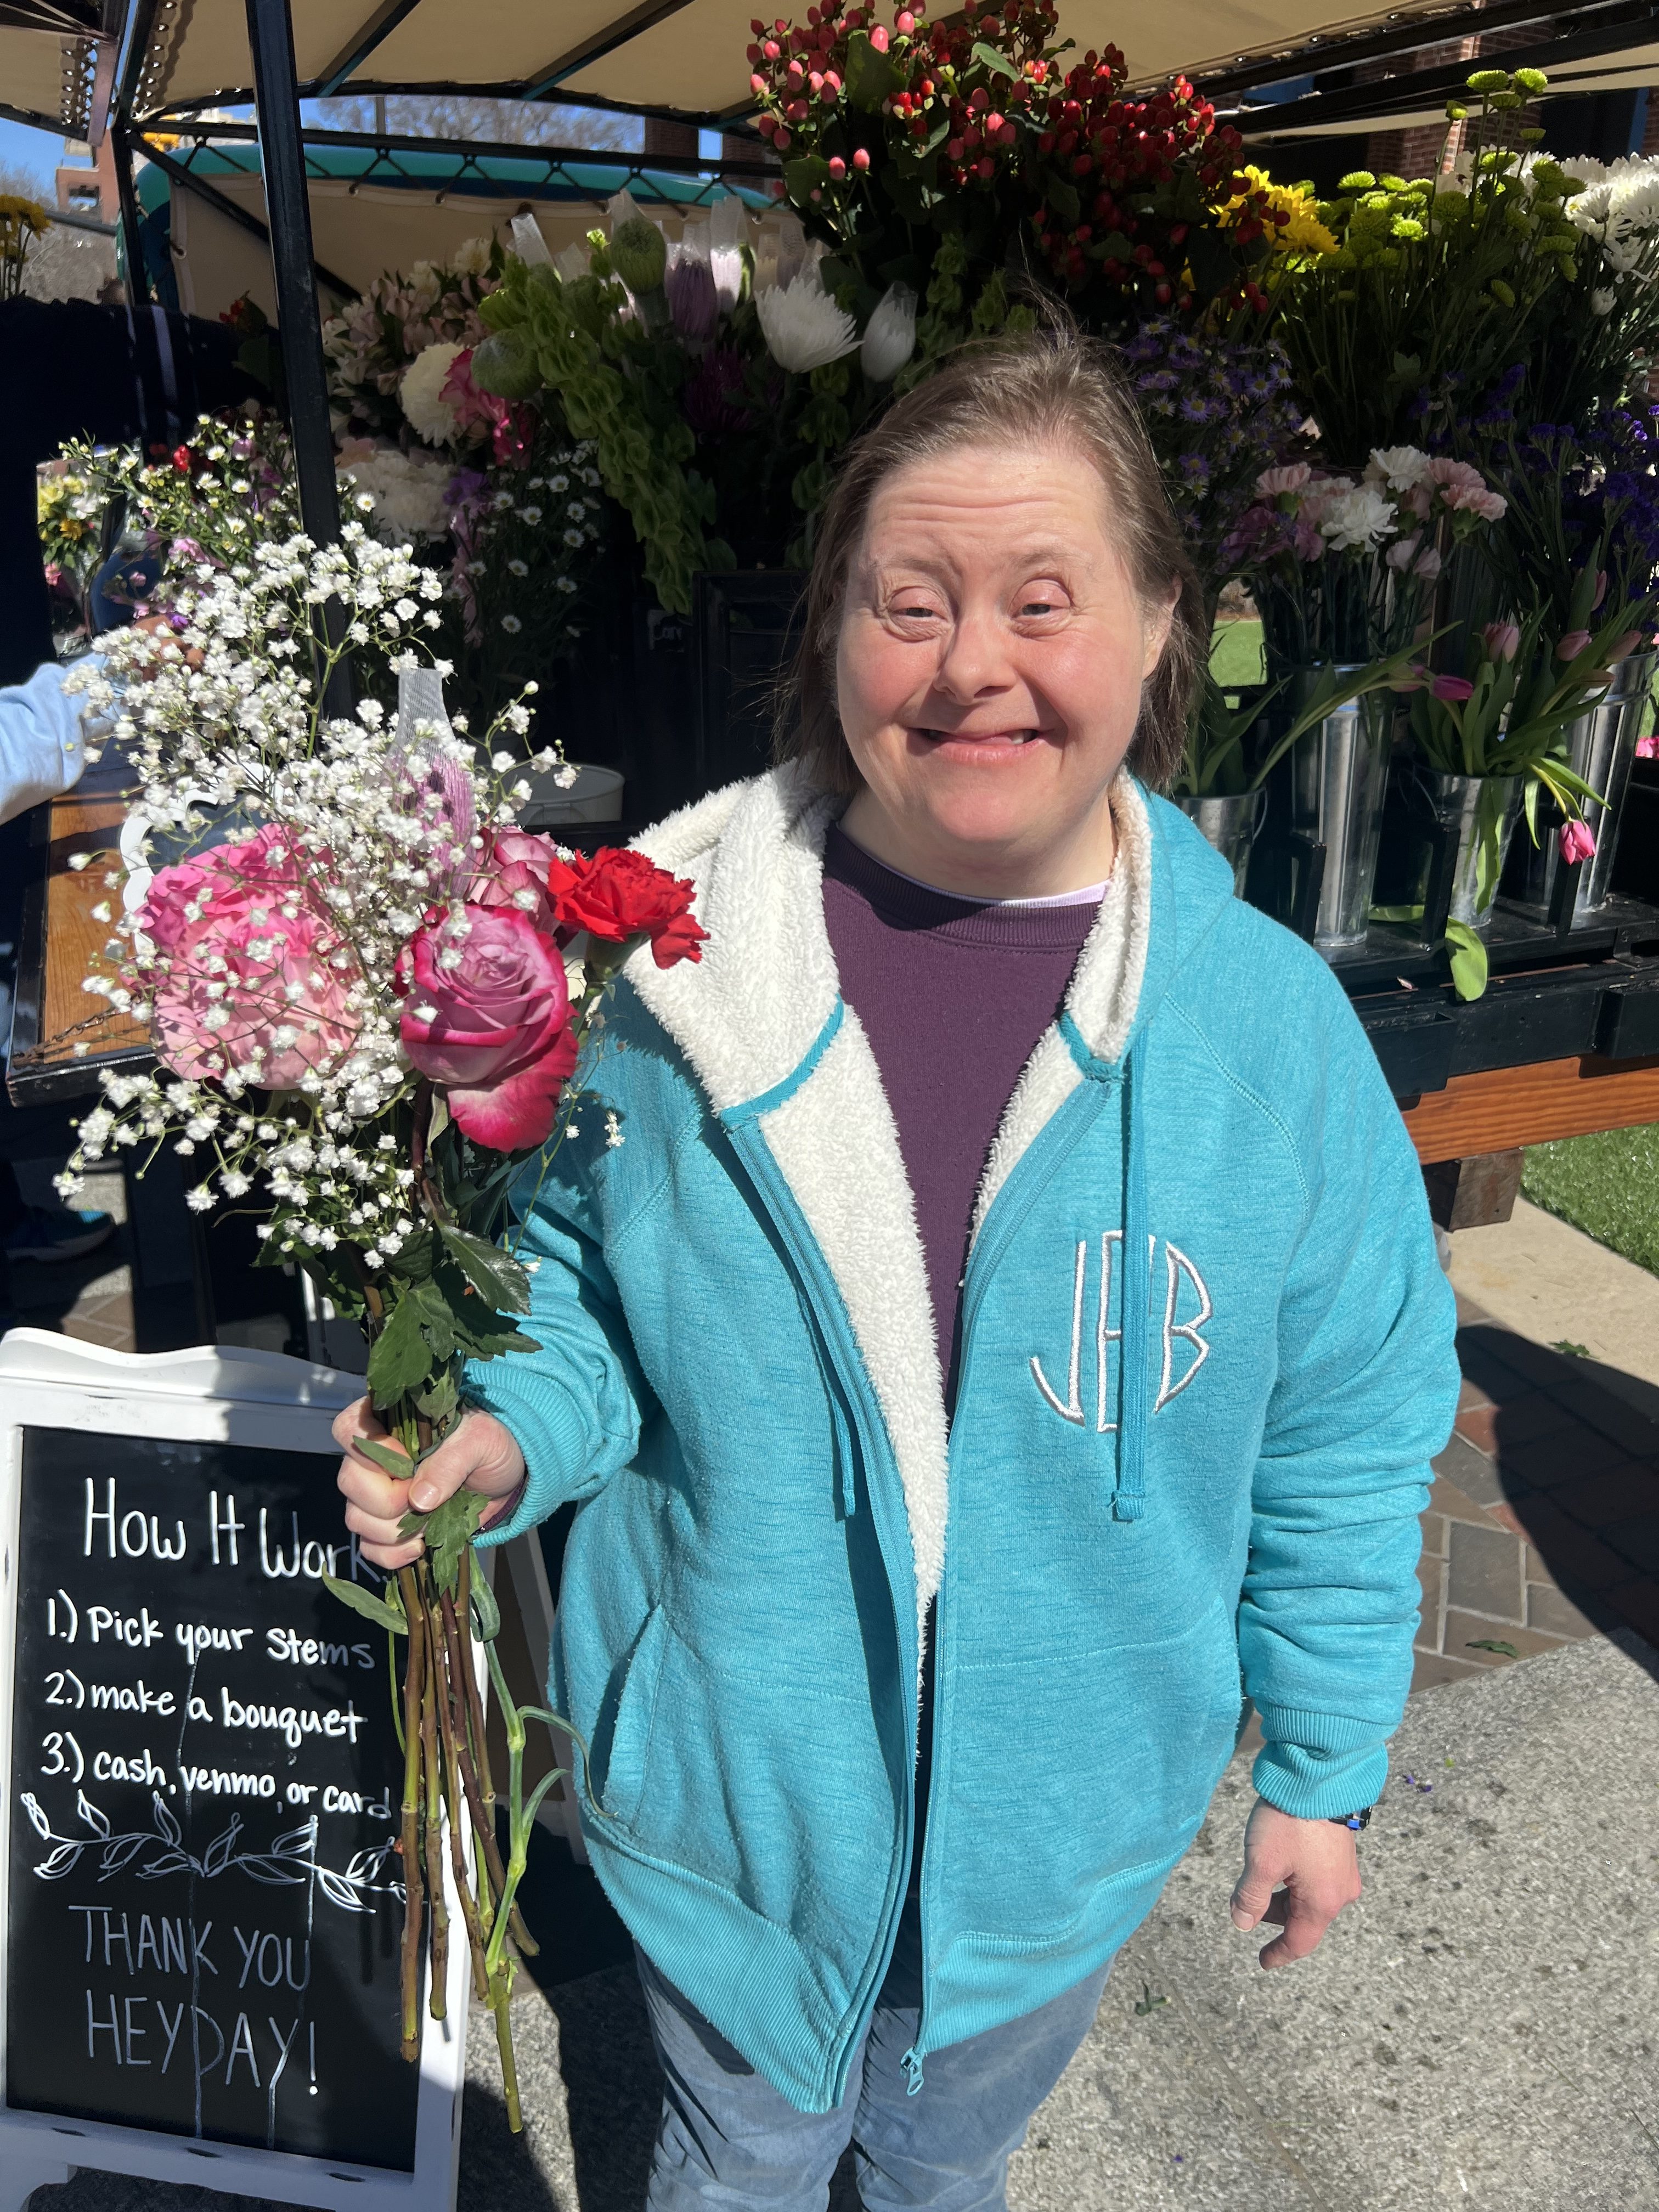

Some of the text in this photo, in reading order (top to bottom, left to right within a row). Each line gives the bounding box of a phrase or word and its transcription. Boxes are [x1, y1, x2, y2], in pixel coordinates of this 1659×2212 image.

[83, 1477, 388, 1583] How It Work
[47, 1589, 78, 1643] 1.)
[87, 1606, 163, 1646] Pick
[175, 1623, 253, 1666] your
[44, 1669, 368, 1748] 2.) make a bouquet
[41, 1731, 84, 1783] 3.)
[179, 1766, 283, 1814] venmo,
[286, 1783, 318, 1804] or
[68, 1905, 311, 1991] THANK YOU
[86, 1989, 319, 2097] HEYDAY!
